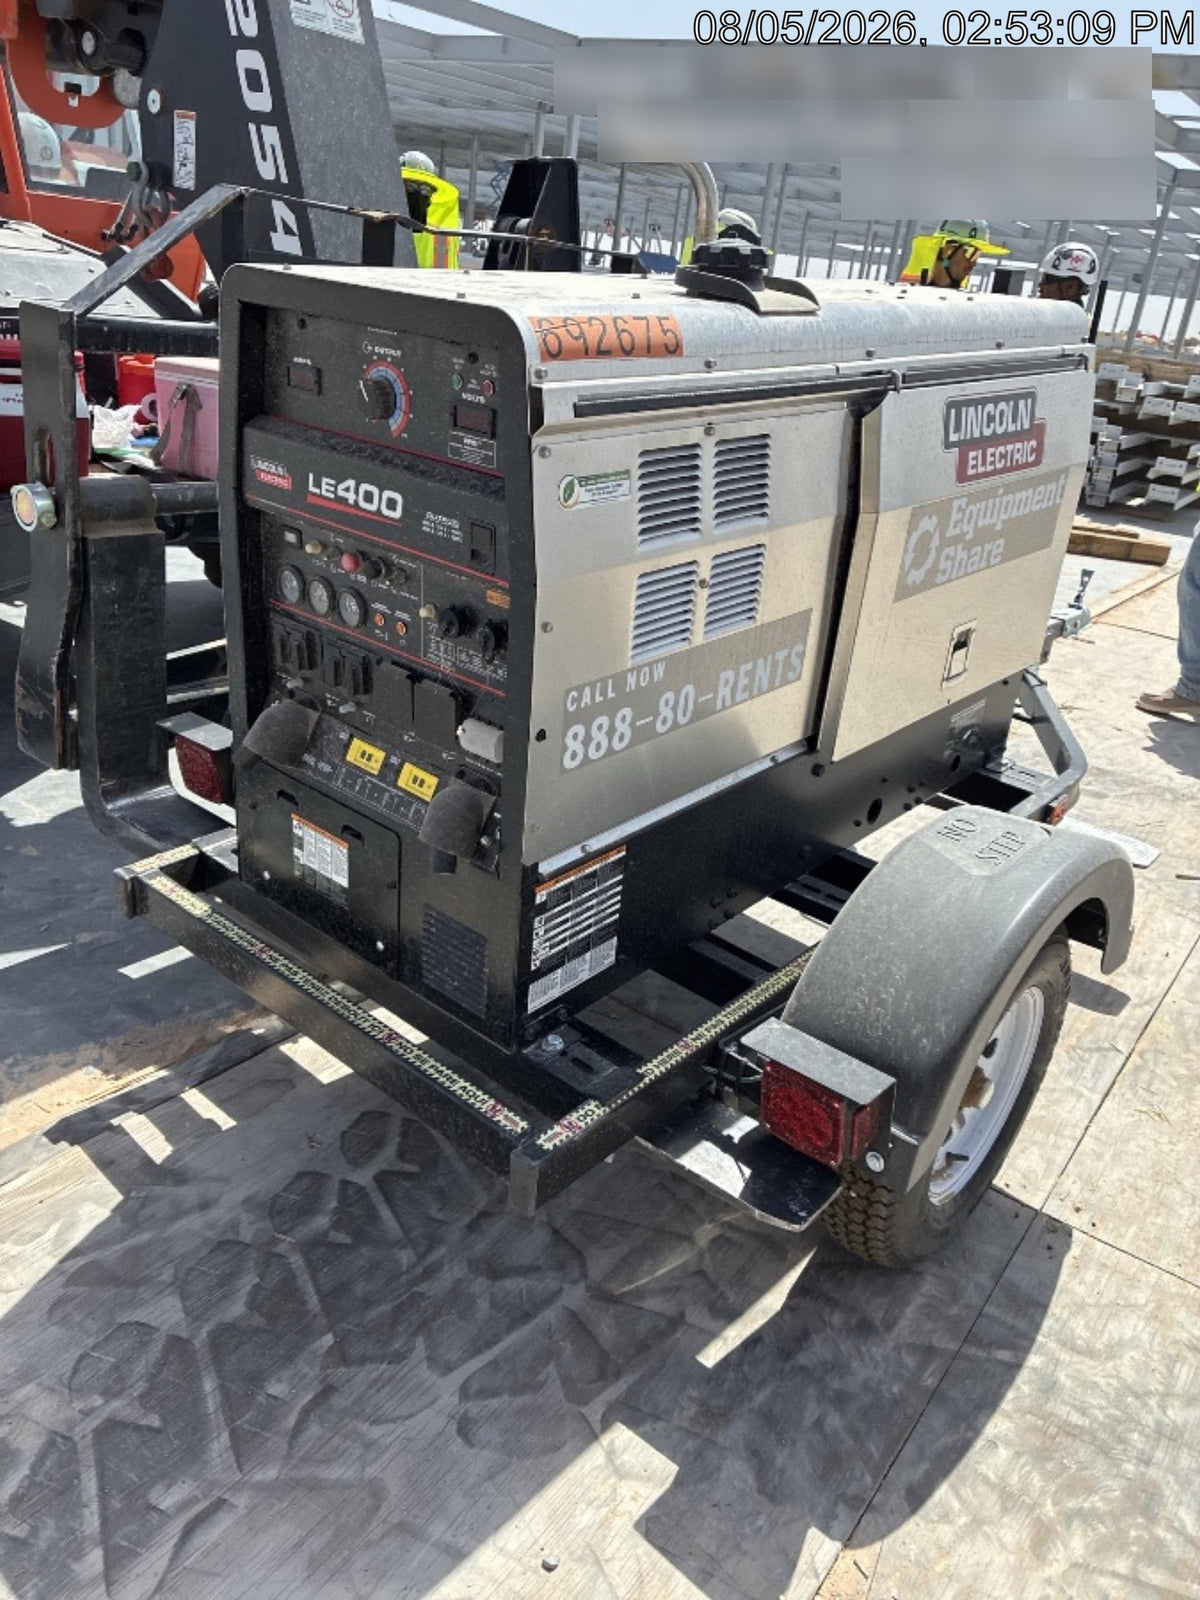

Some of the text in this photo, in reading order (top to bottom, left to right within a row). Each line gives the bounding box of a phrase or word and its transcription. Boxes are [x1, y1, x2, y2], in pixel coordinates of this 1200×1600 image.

[536, 315, 680, 359] 692675
[948, 398, 1032, 442] LINCOLN
[966, 439, 1037, 475] ELECTRIC
[308, 472, 403, 519] LE400
[946, 473, 1067, 541] Equipment
[934, 538, 1005, 584] Share
[563, 644, 804, 769] 888-80-RENTS
[566, 661, 666, 712] CALL NOW
[937, 818, 977, 842] NO
[399, 1041, 413, 1055] NO
[428, 1064, 460, 1087] PARE
[460, 1085, 488, 1105] AQUI
